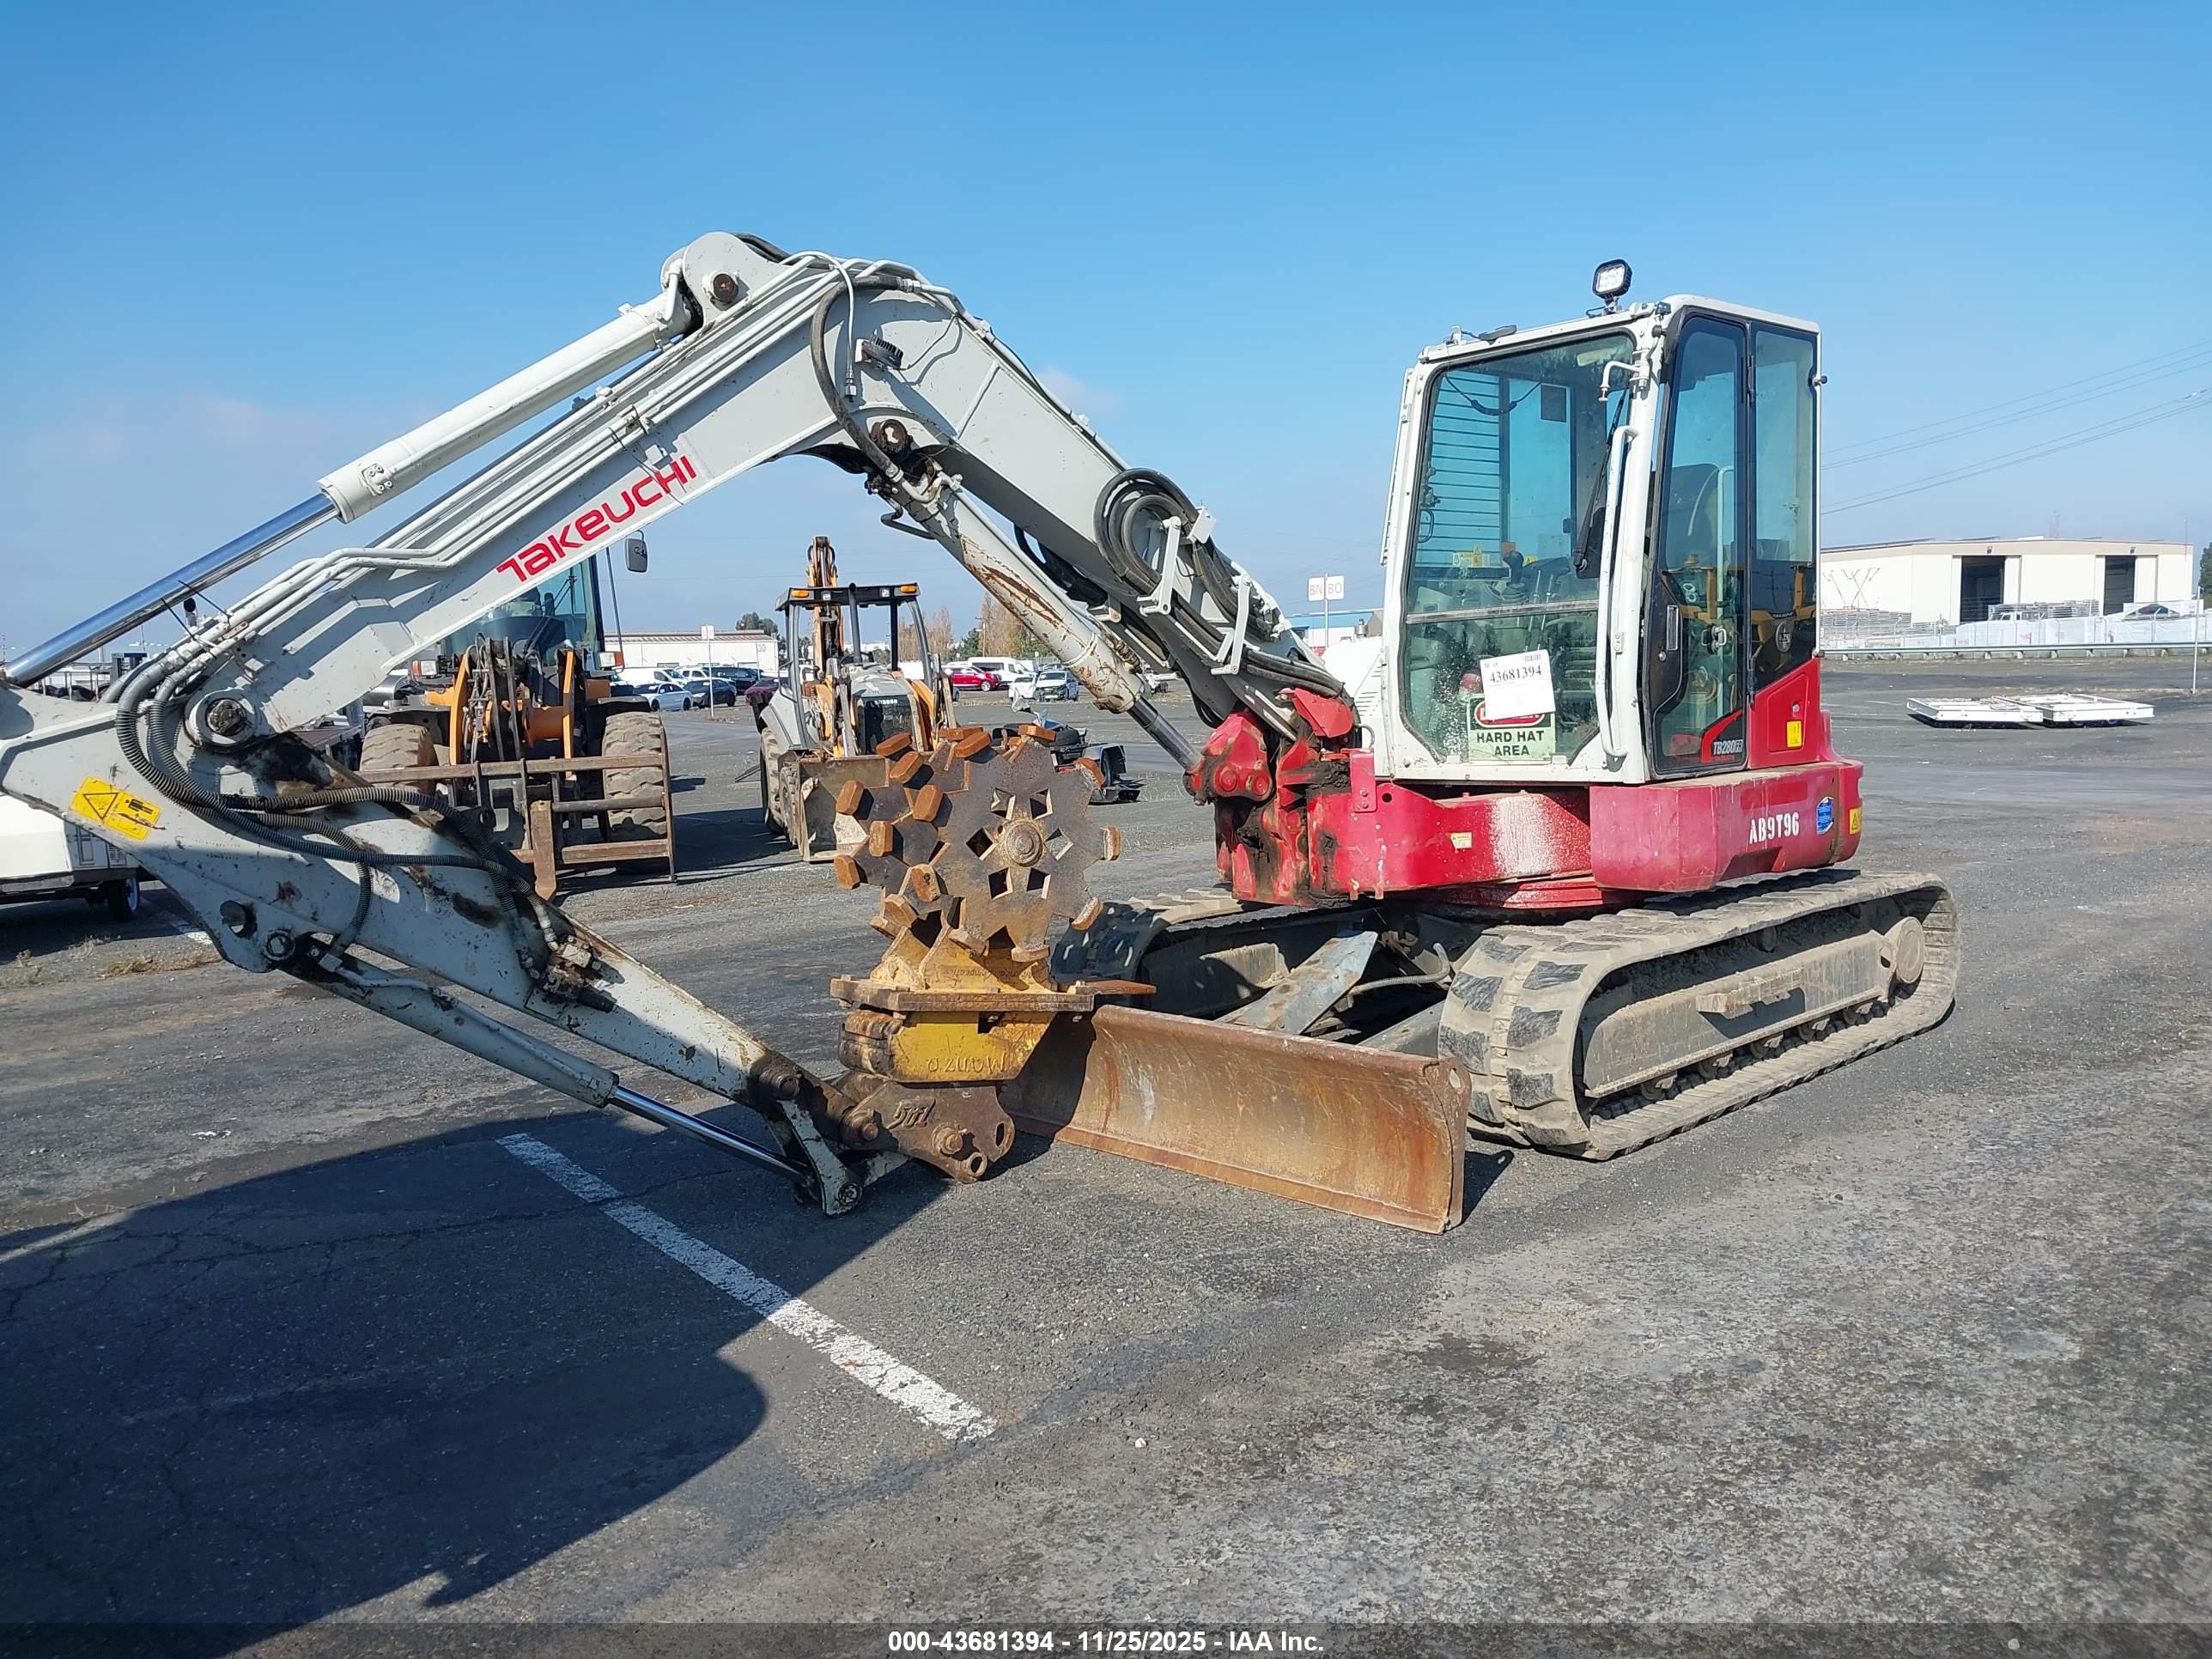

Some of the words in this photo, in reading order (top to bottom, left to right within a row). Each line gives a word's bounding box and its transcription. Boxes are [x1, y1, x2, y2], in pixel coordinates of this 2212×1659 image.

[1310, 584, 1322, 595] BN
[1328, 582, 1341, 593] BO
[1490, 665, 1541, 684] 43681394
[1477, 732, 1512, 743] HARD
[1517, 730, 1544, 742] HAT
[1495, 744, 1529, 757] AREA
[1749, 811, 1800, 844] AB9T96
